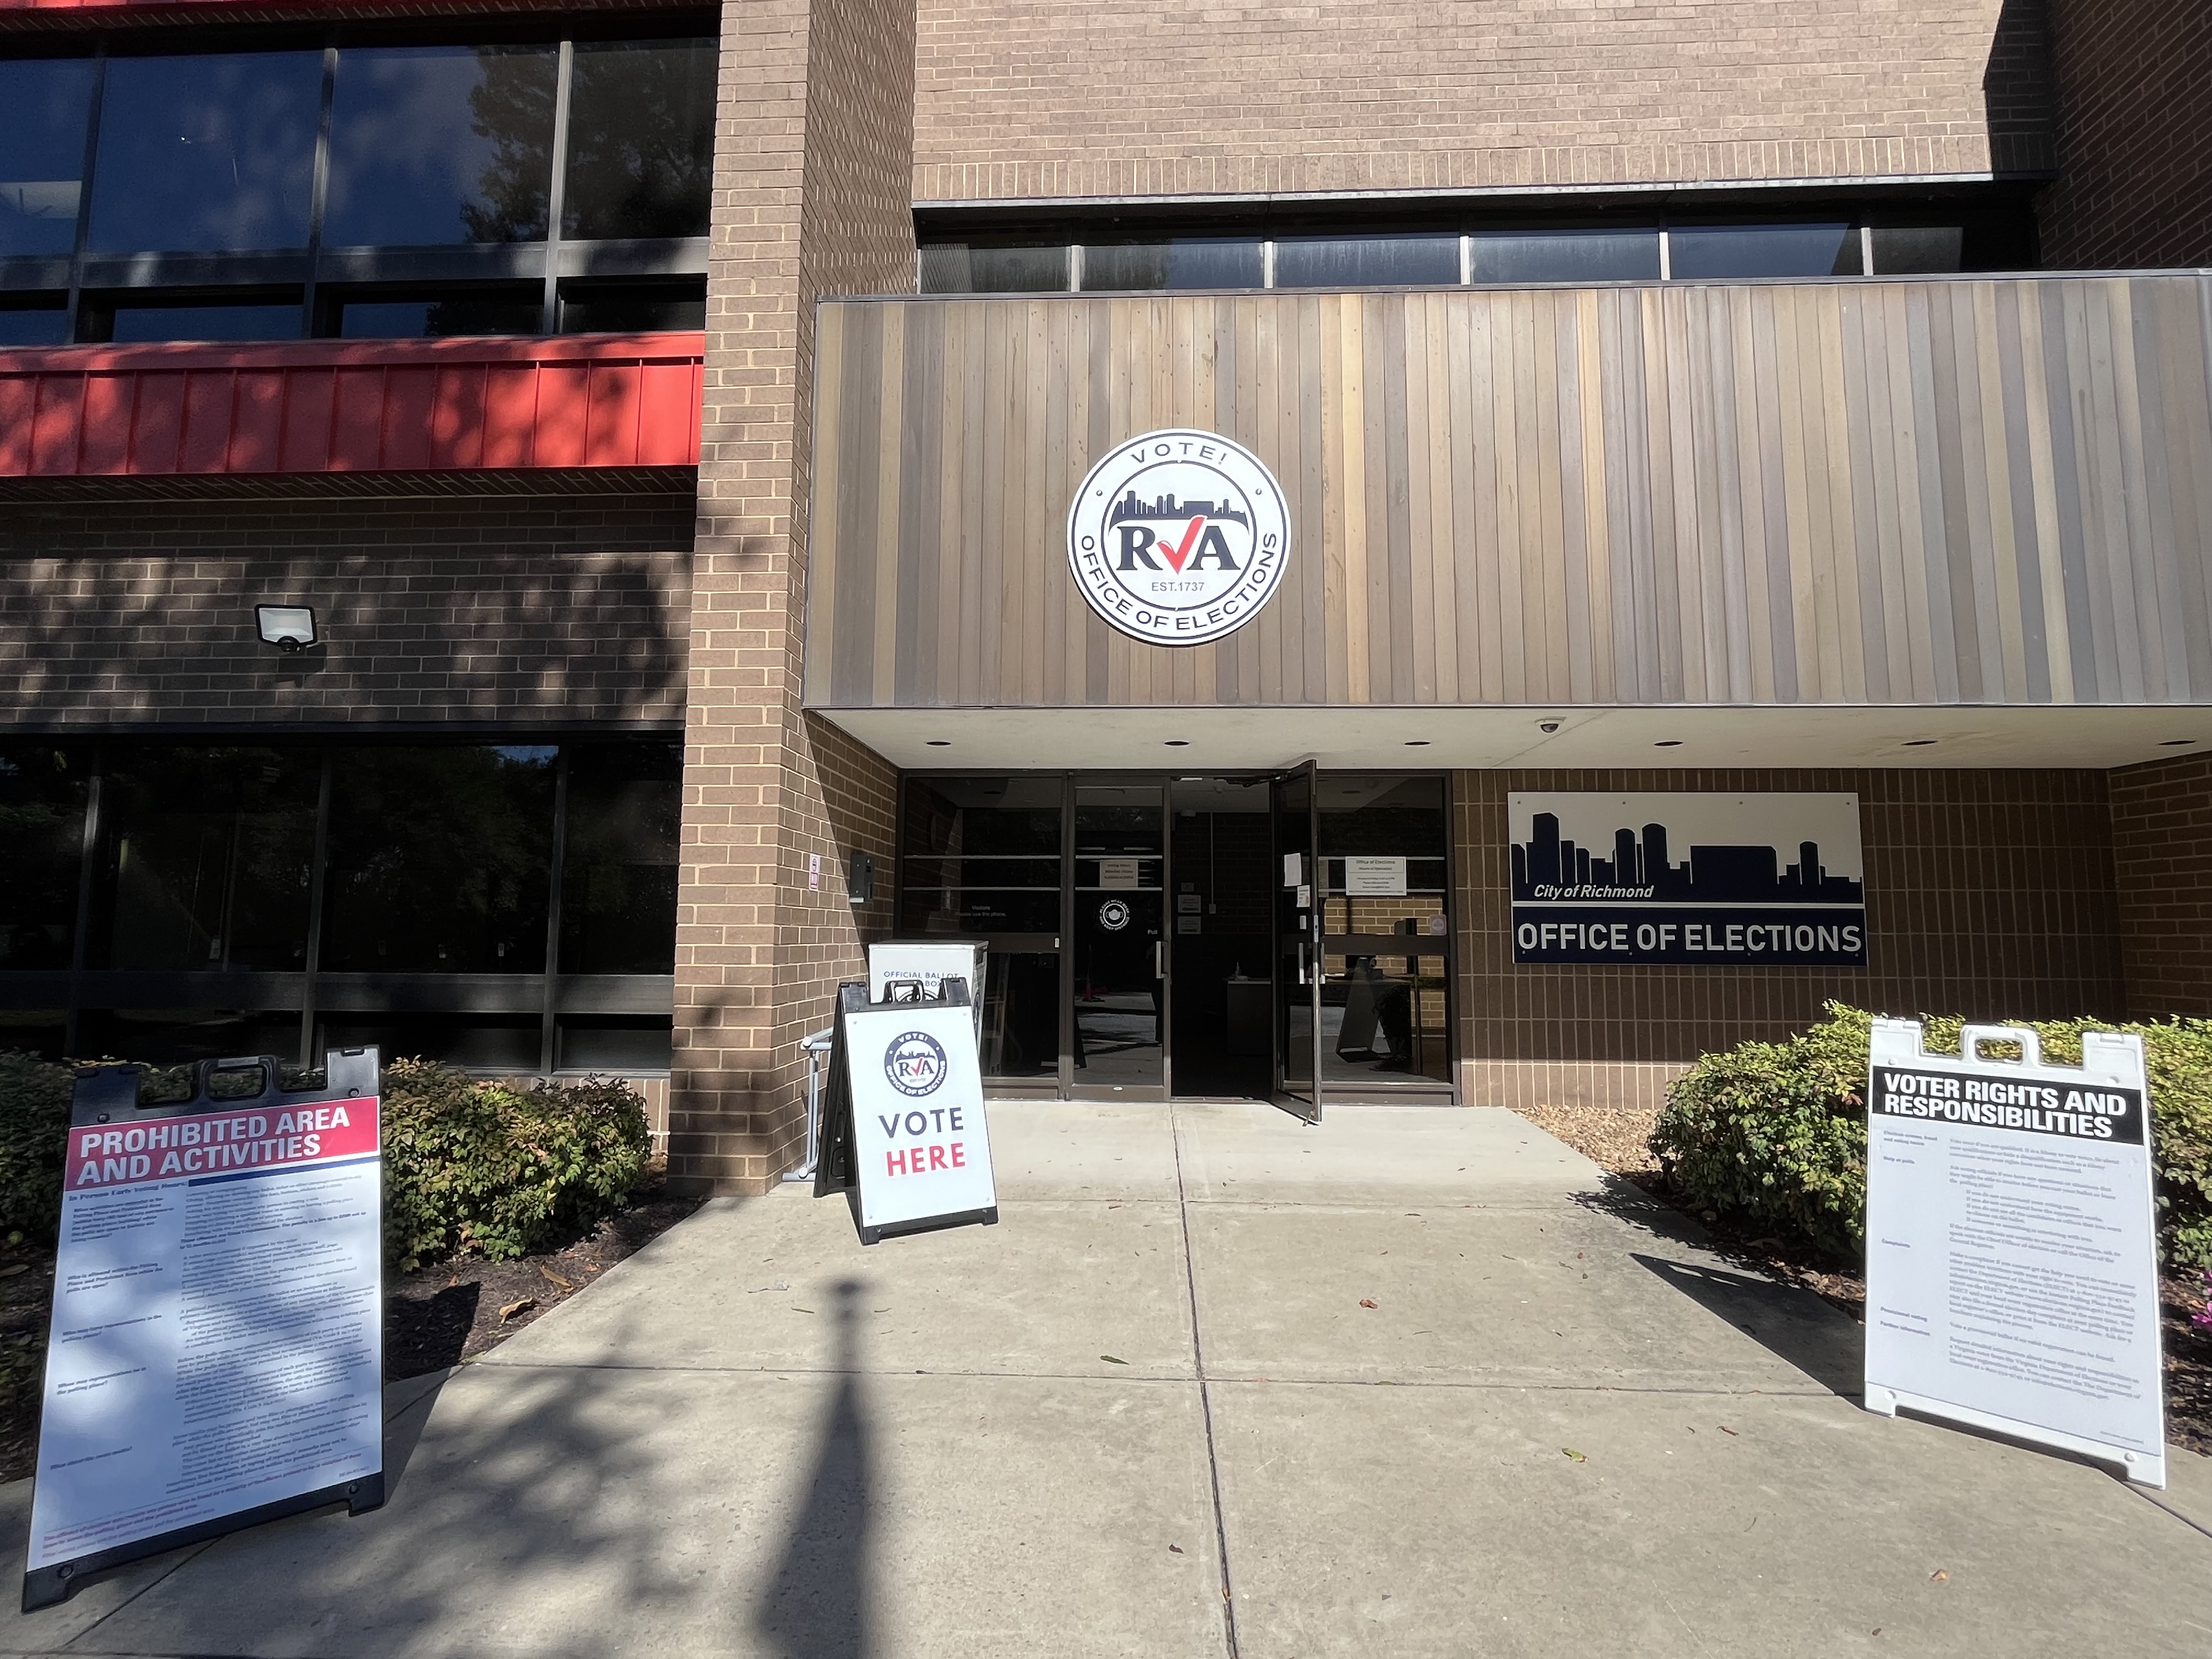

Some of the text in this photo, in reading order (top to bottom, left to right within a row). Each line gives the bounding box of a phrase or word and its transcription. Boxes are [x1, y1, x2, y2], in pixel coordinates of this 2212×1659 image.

[1131, 442, 1227, 465] VOTE!
[1081, 533, 1277, 630] OFFICE OF ELECTIONS
[1152, 582, 1205, 592] EST.1737
[1533, 884, 1654, 900] City of Richmond
[1517, 923, 1861, 952] OFFICE OF ELECTIONS
[898, 1033, 928, 1042] VOTE!
[1883, 1073, 2127, 1116] VOTER RIGHTS AND
[80, 1106, 351, 1158] PROHIBITED AREA
[878, 1107, 964, 1139] VOTE
[1883, 1093, 2113, 1138] RESPONSIBILITIES
[76, 1133, 321, 1186] AND ACTIVITIES
[886, 1143, 966, 1177] HERE
